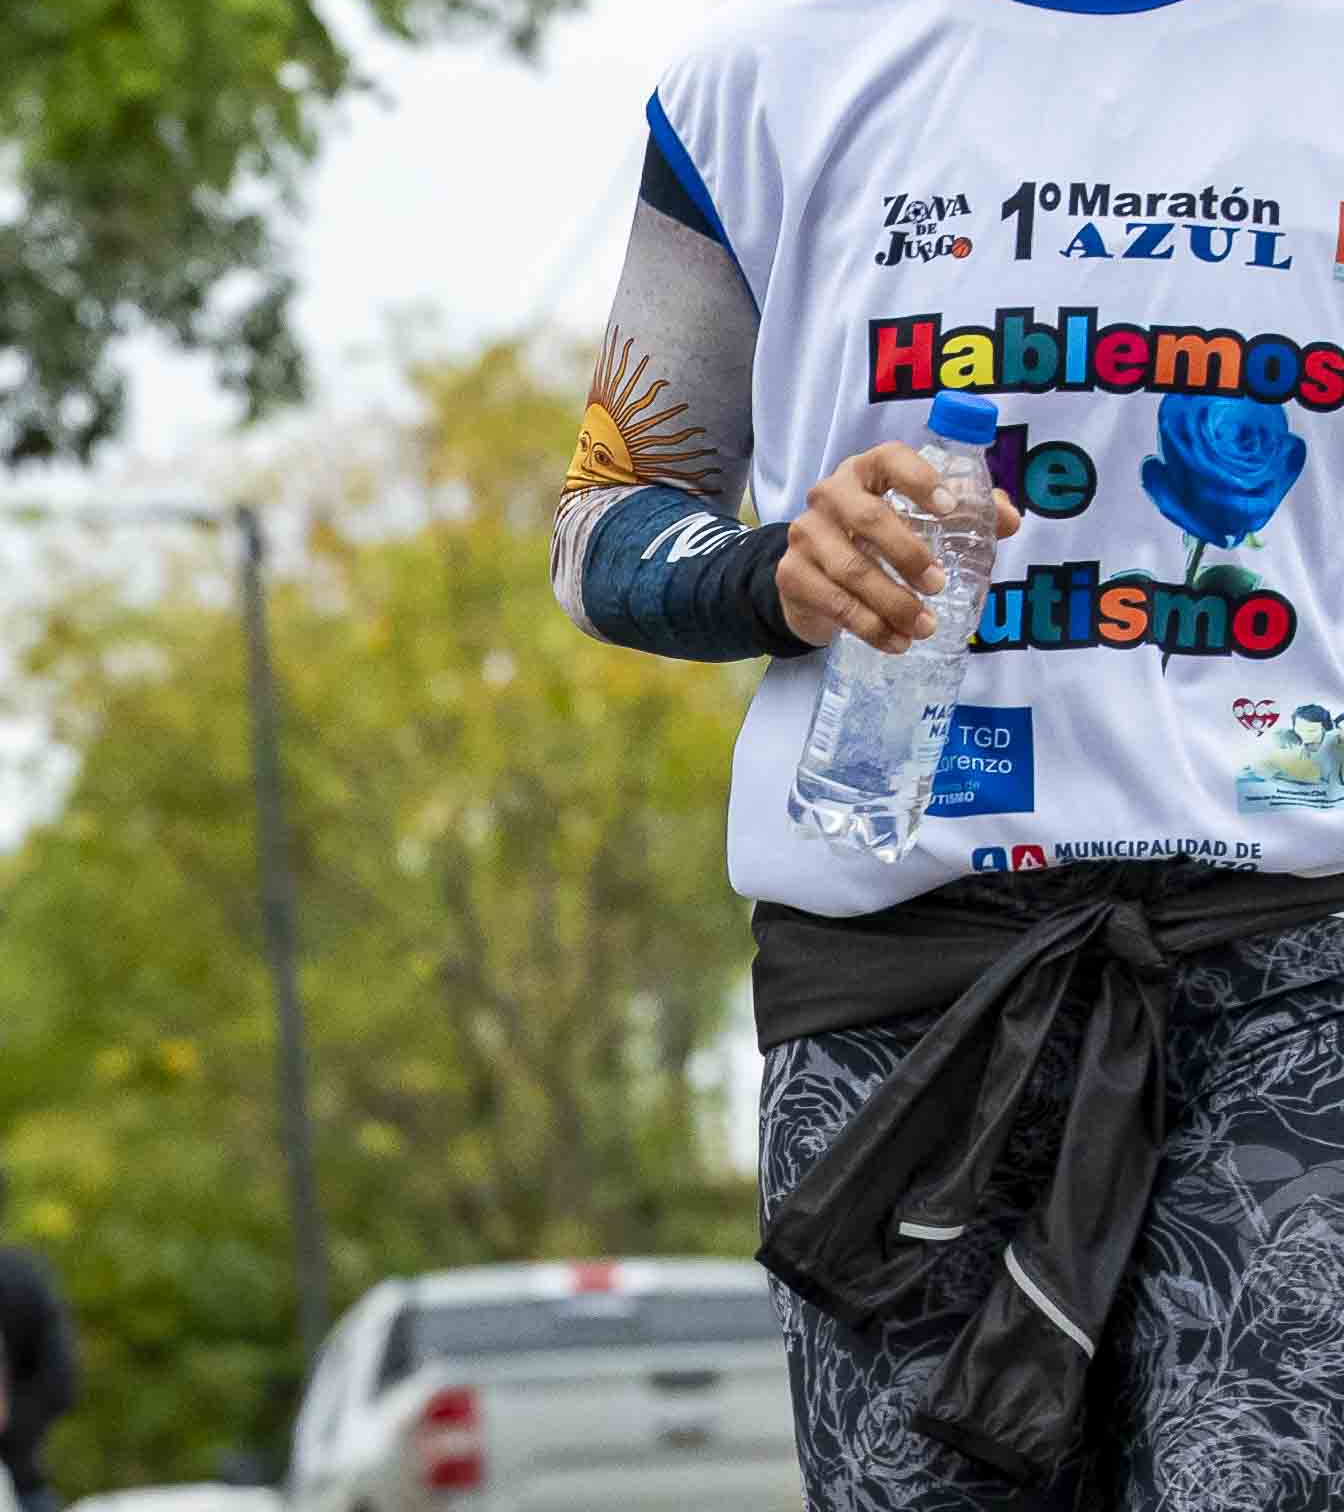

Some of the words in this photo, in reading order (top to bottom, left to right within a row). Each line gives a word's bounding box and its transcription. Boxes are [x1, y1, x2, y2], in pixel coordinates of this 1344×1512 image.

[883, 193, 972, 227] ZONA
[1068, 183, 1280, 226] Maratón
[916, 223, 937, 236] DE
[1059, 222, 1293, 270] AZUL
[869, 307, 1344, 413] Hablemos
[968, 561, 1297, 660] utismo
[959, 725, 1011, 748] TGD
[1054, 839, 1227, 858] MUNICIPALIDAD
[1235, 842, 1262, 859] DE
